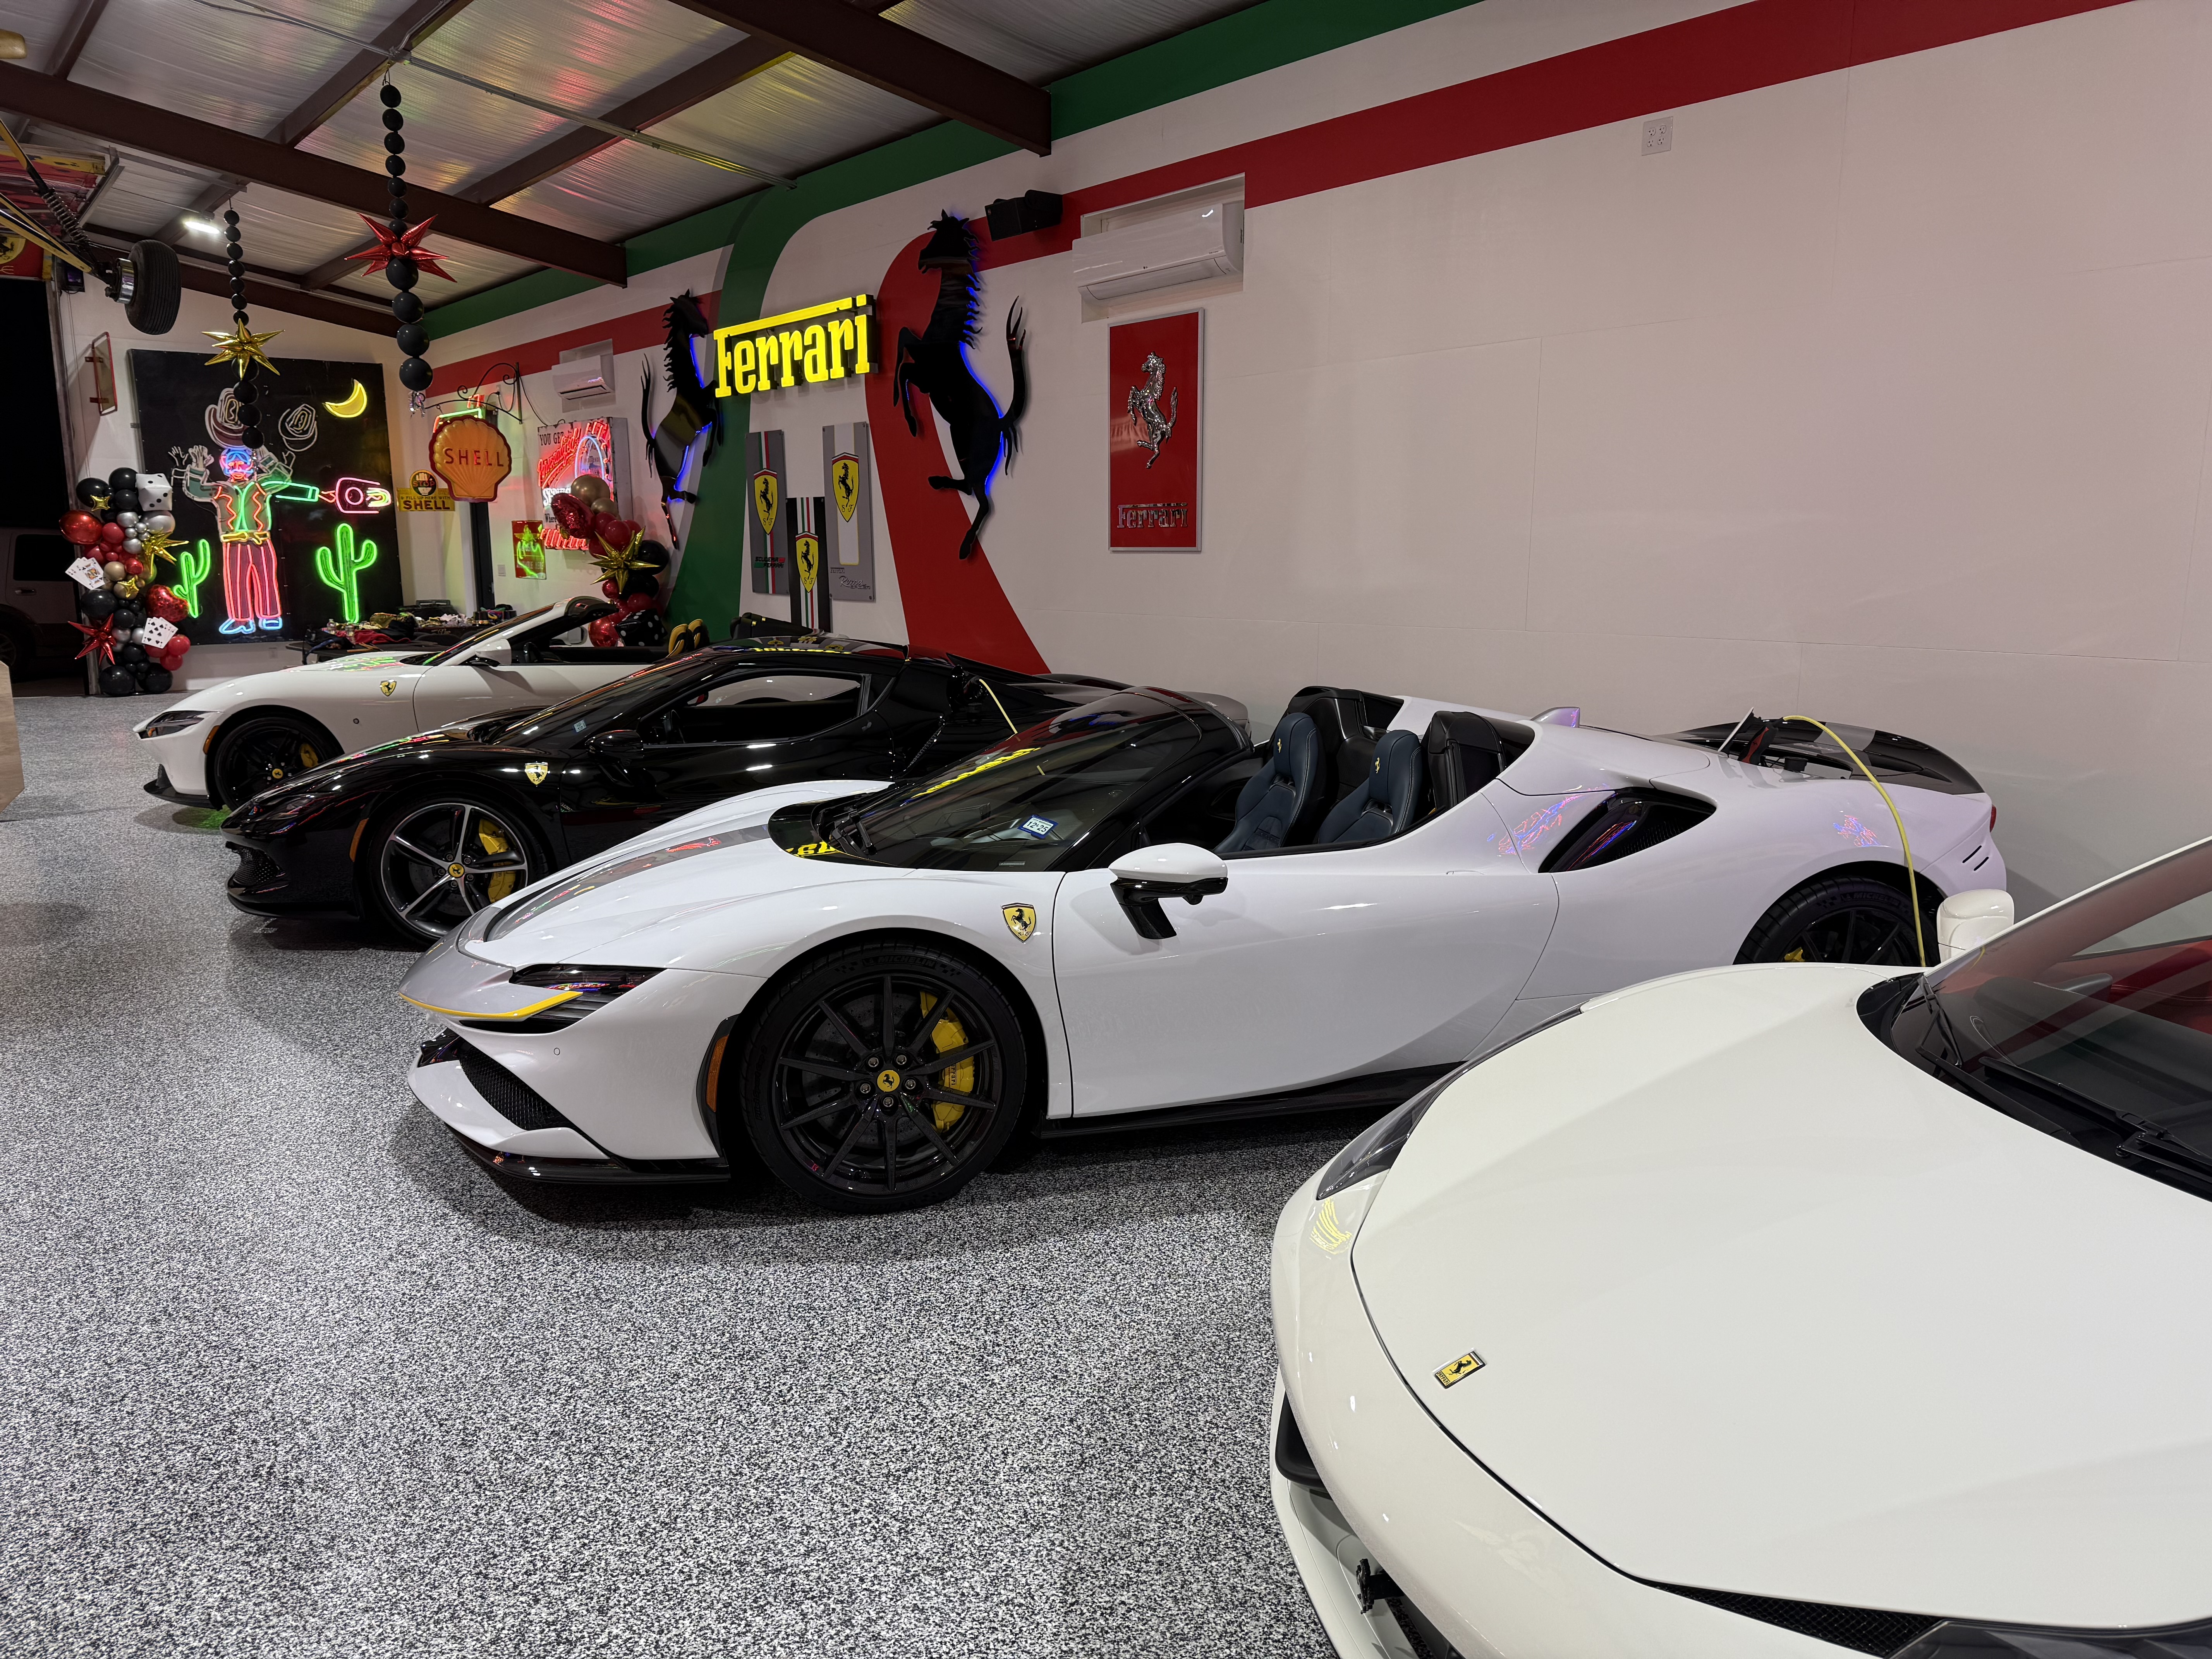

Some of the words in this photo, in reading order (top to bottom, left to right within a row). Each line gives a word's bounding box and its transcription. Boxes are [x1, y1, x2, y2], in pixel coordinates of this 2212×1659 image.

[713, 294, 870, 398] Ferrari
[539, 433, 551, 445] YOU
[444, 448, 504, 467] SHELL
[403, 500, 450, 510] SHELL
[1117, 502, 1188, 528] Ferrari
[839, 576, 866, 587] Roma
[1853, 892, 1900, 906] MICHELIN
[878, 956, 936, 967] MICHELIN
